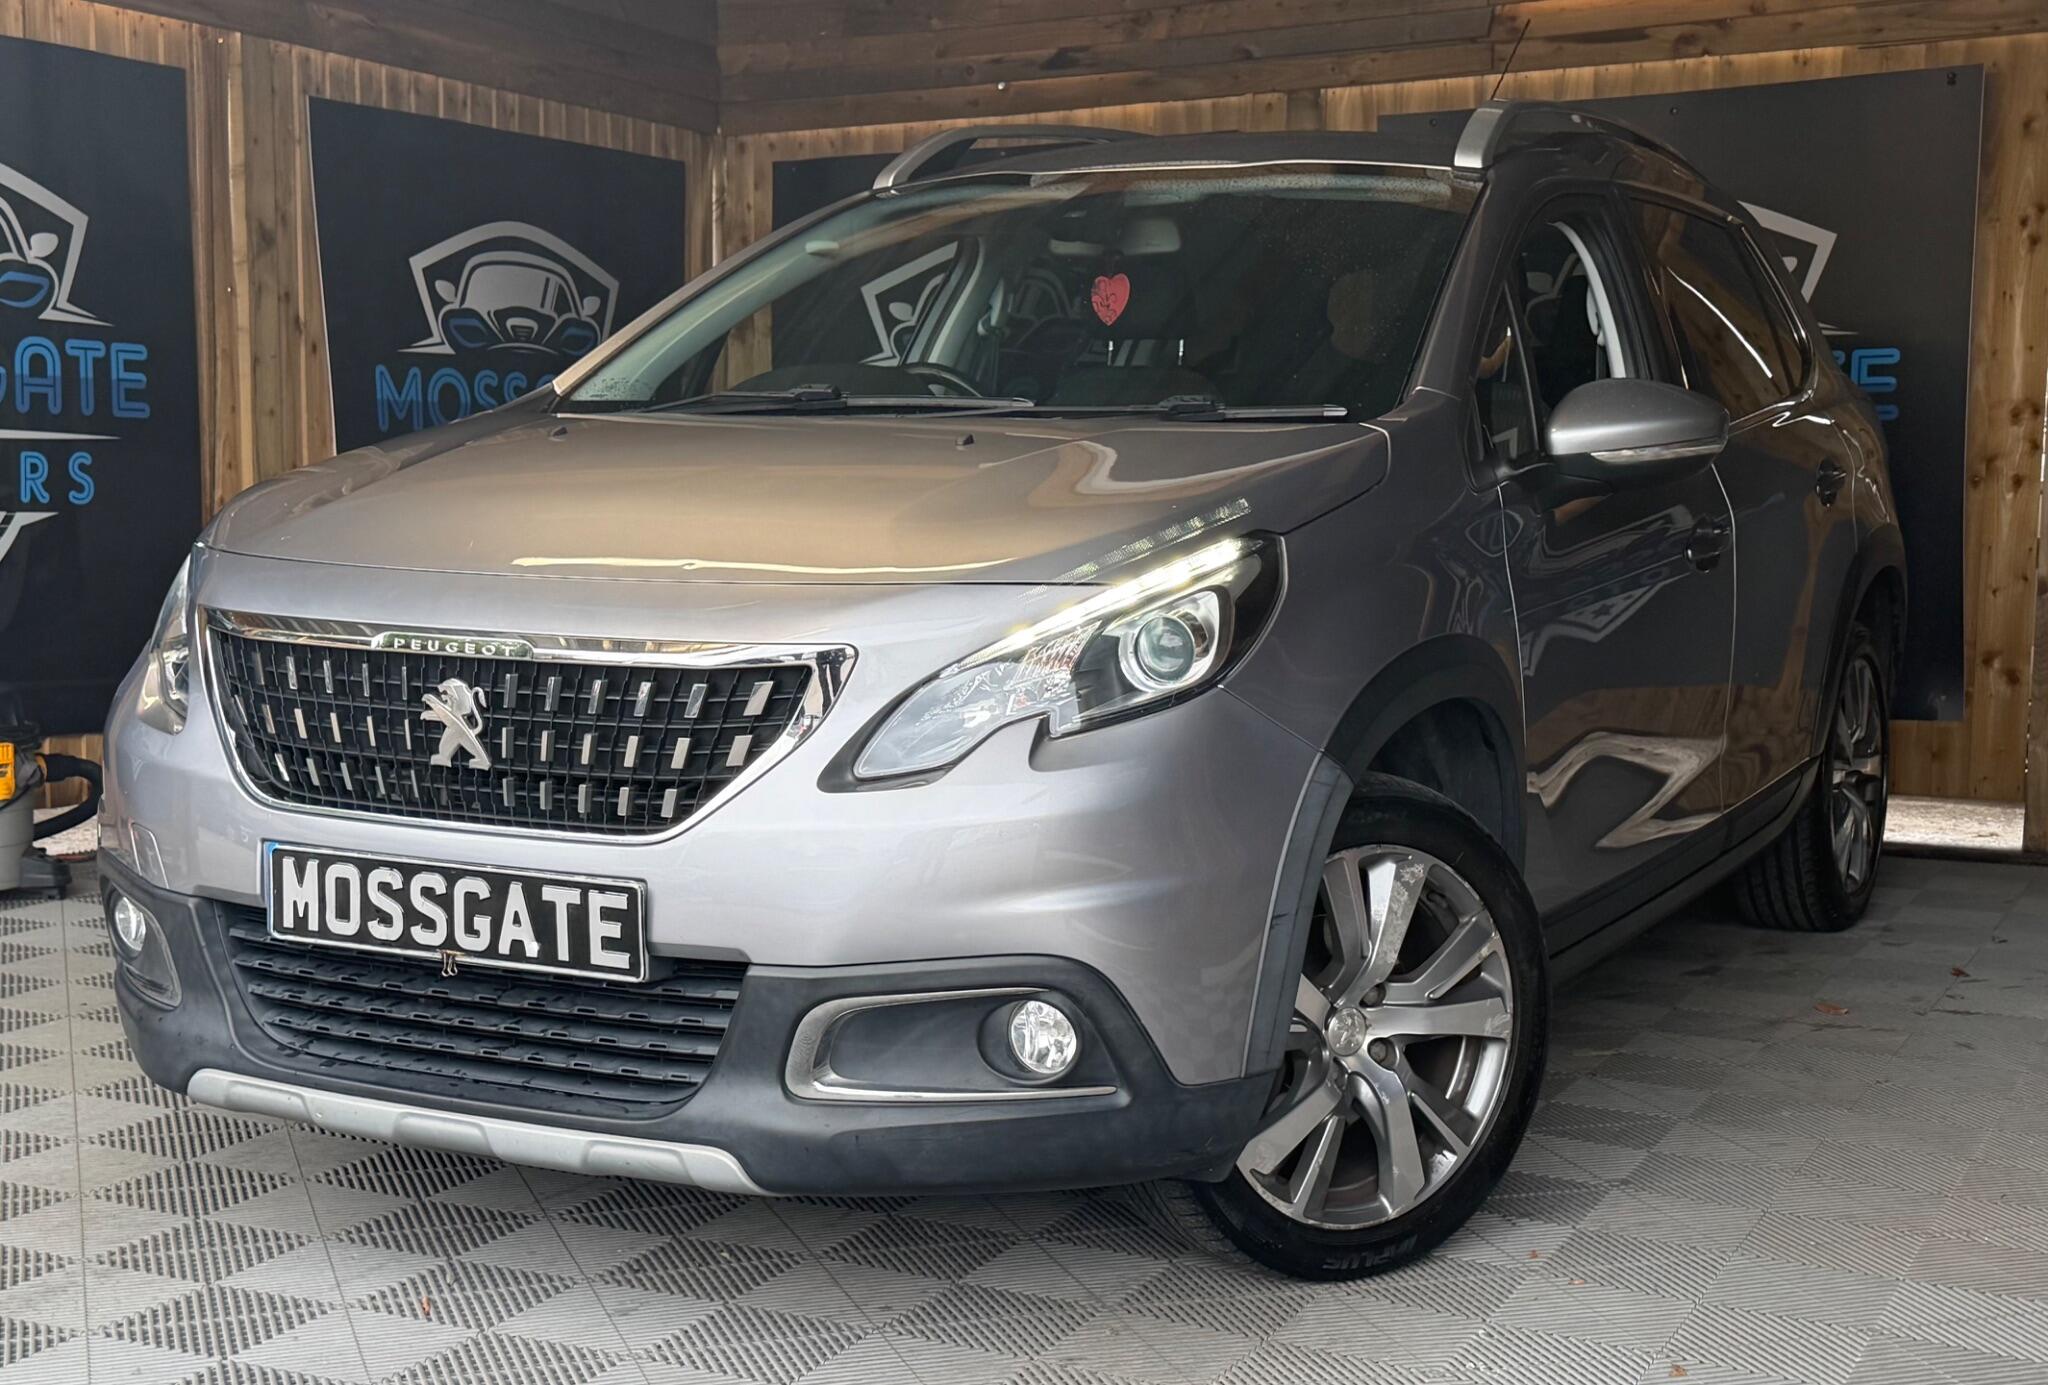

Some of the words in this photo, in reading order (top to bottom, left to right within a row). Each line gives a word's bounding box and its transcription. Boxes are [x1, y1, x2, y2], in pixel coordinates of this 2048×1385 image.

[0, 335, 150, 419] ATE
[393, 637, 515, 657] PEUGEOT
[281, 855, 631, 970] MOSSGATE
